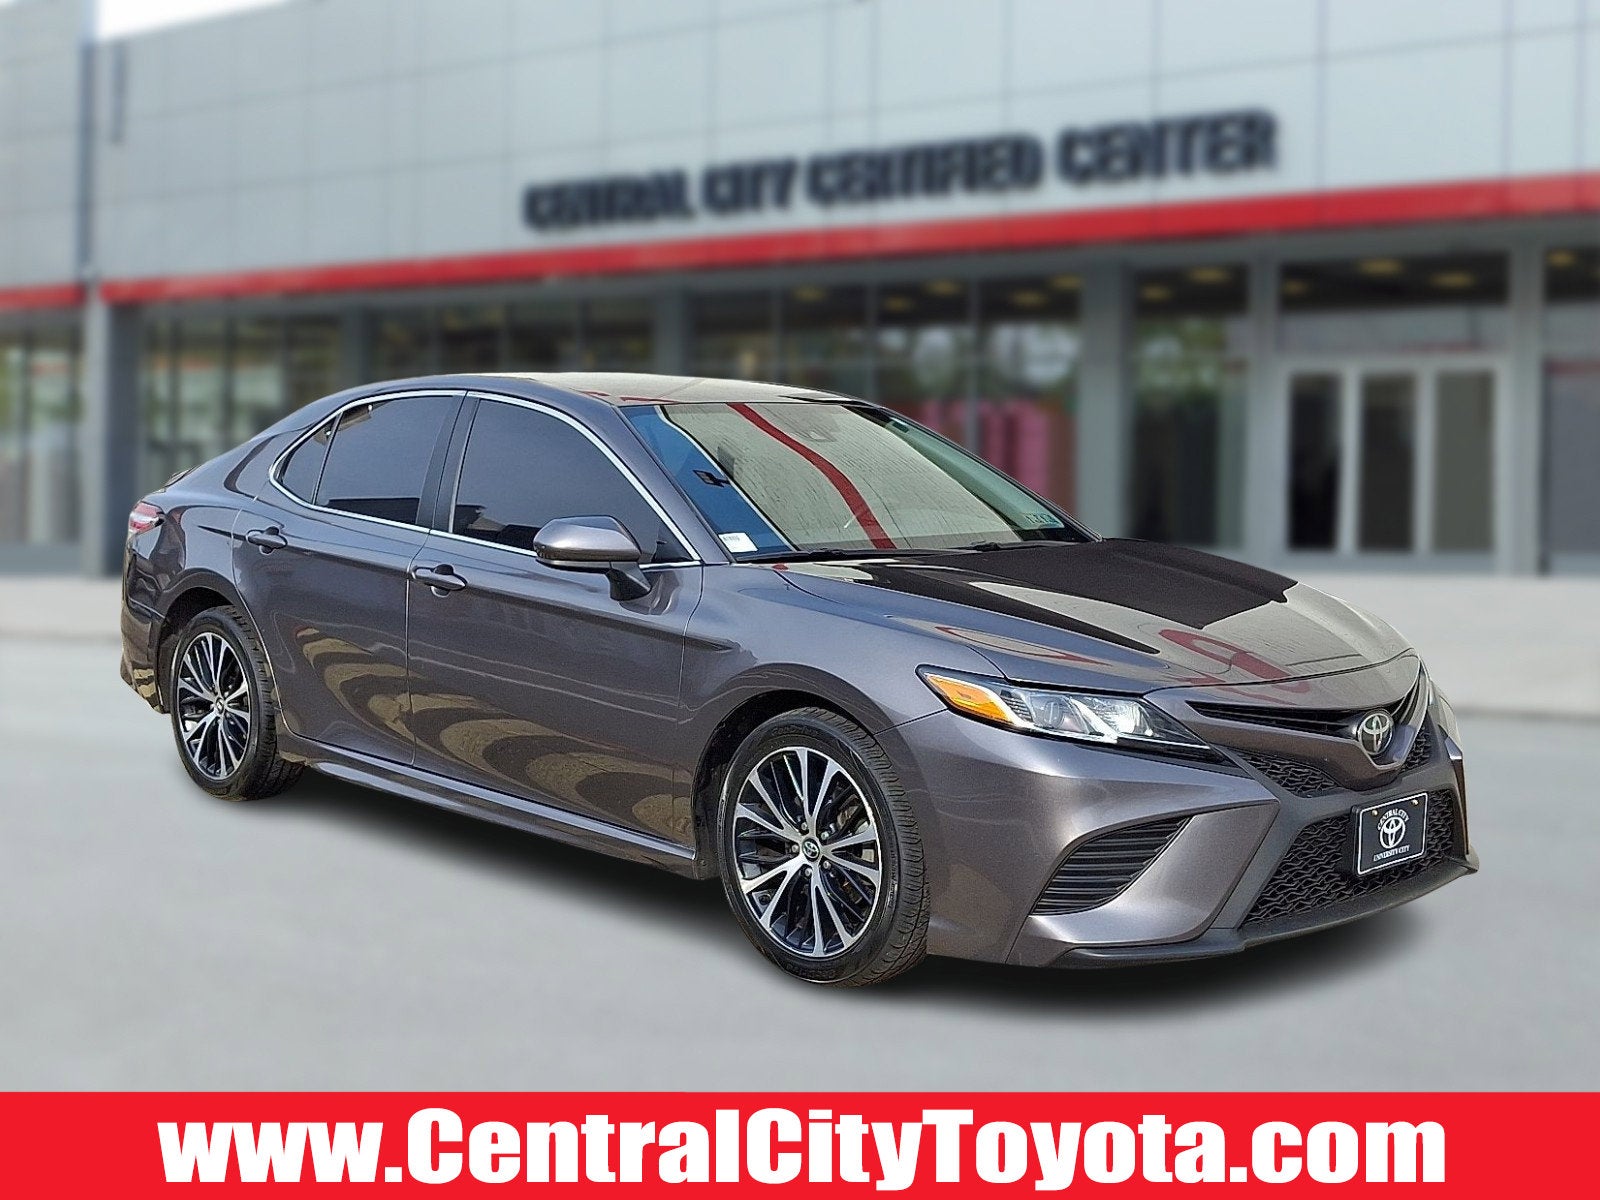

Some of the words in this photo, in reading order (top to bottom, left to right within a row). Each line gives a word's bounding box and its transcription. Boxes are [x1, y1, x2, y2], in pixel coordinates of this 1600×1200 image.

[522, 167, 695, 233] CENTRAL
[702, 156, 799, 217] CITY
[804, 132, 1047, 208] CERTIFIED
[1056, 108, 1278, 184] CENTER
[1378, 809, 1398, 830] CENTRAL
[1398, 809, 1409, 822] CITY
[1399, 845, 1410, 853] CITY
